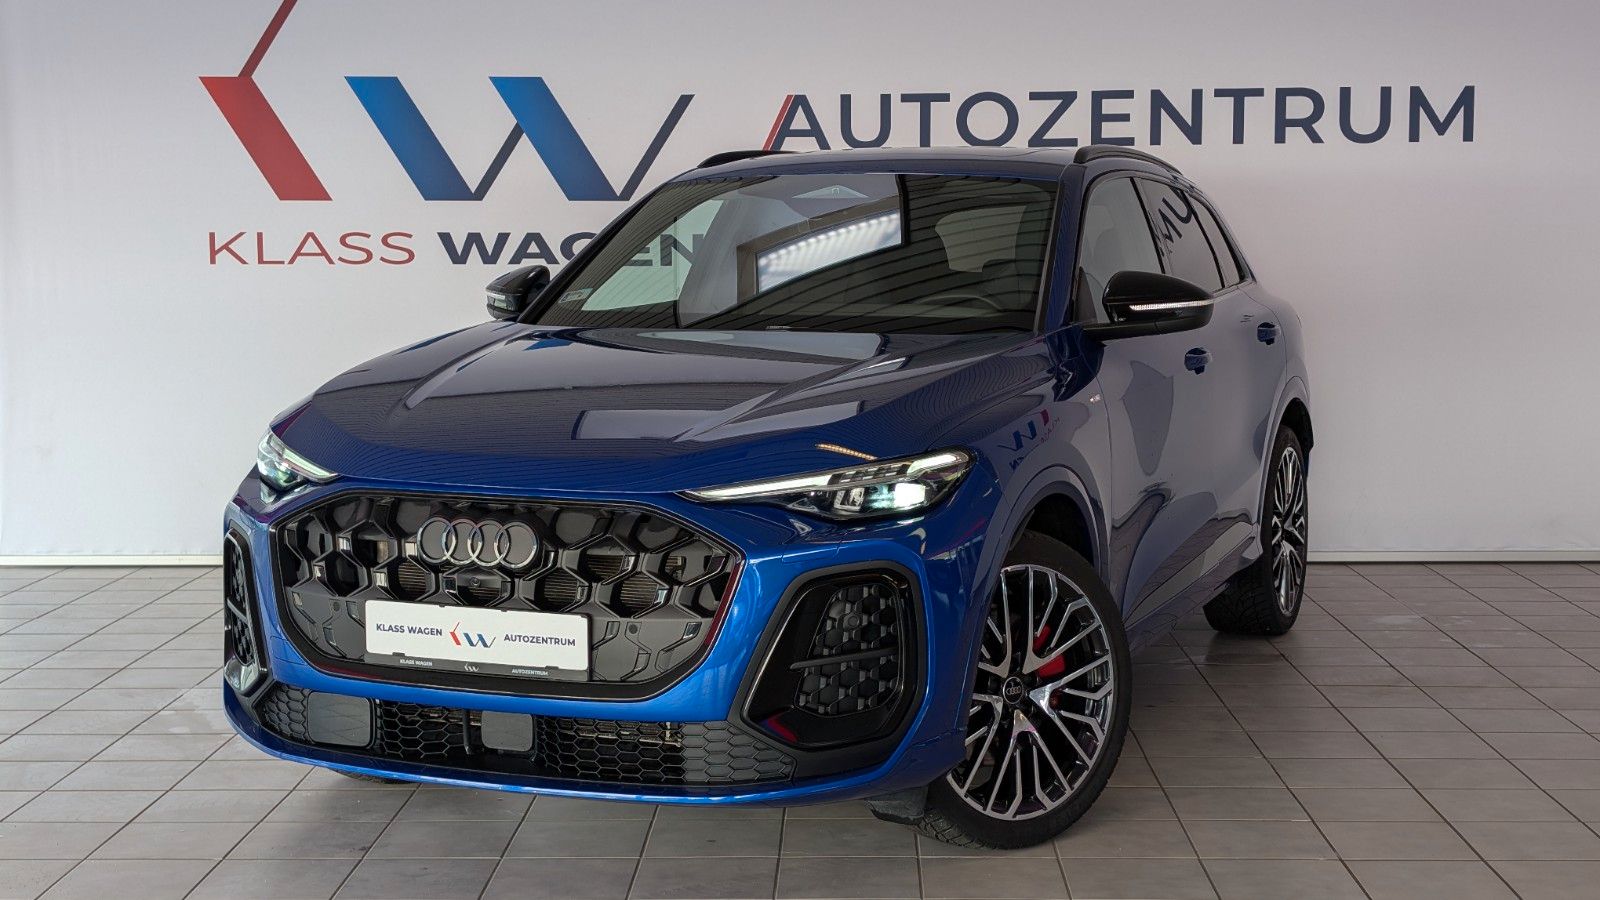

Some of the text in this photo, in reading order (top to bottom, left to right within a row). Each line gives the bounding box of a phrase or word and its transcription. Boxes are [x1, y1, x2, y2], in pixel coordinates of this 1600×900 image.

[762, 86, 1475, 147] AUTOZENTRUM
[208, 232, 415, 265] KLASS
[376, 623, 405, 634] KLASS
[407, 626, 443, 636] WAGEN
[503, 634, 576, 646] AUTOZENTRUM
[511, 668, 549, 677] AUTOZENTRUM
